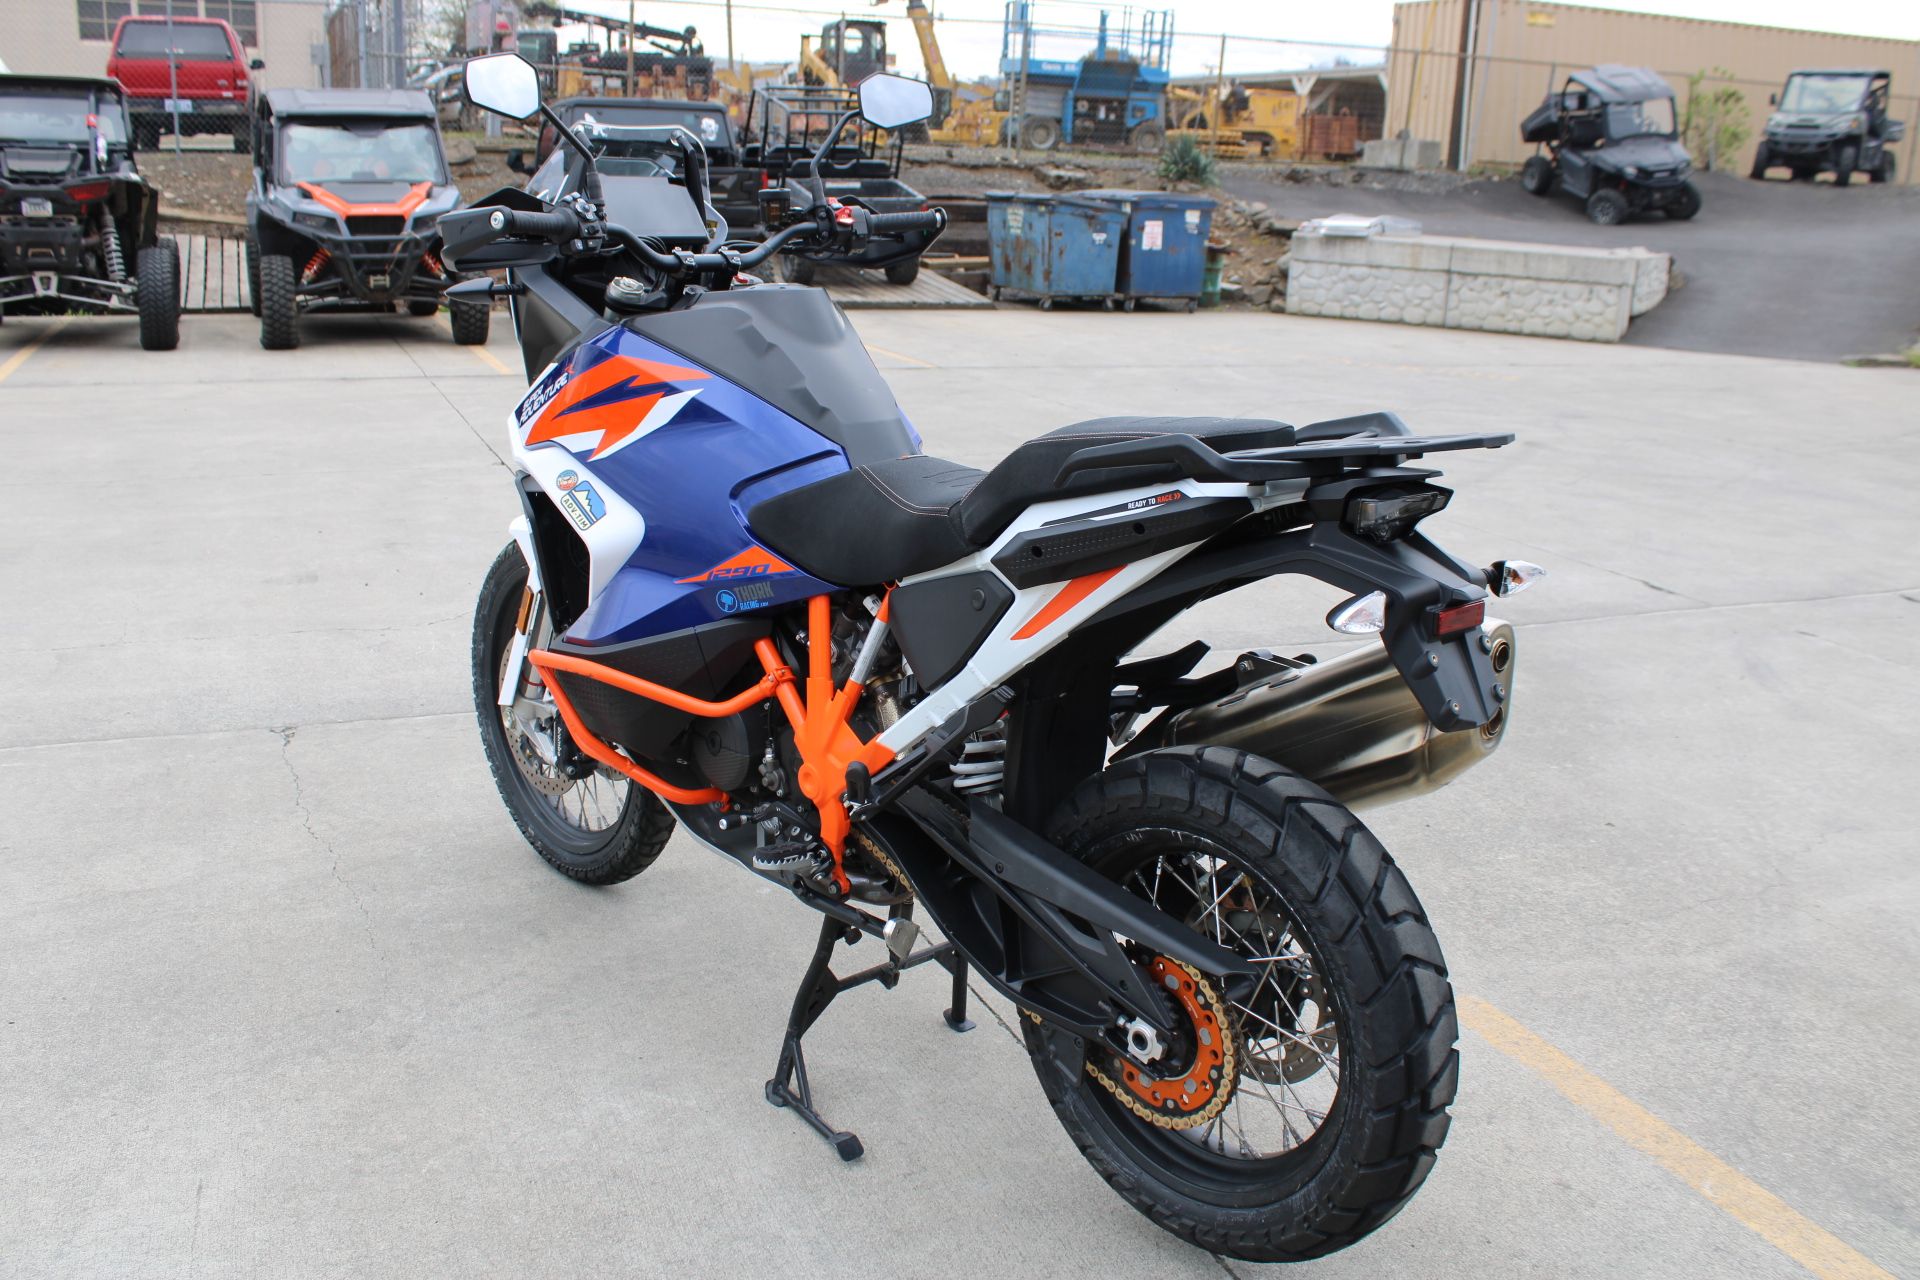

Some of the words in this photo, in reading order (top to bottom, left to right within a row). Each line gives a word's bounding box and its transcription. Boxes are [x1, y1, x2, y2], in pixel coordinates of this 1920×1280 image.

[519, 372, 569, 425] ADVENTURE
[522, 384, 544, 413] SUPER
[563, 498, 589, 529] ADV-TIM
[1127, 499, 1147, 510] READY
[1148, 497, 1156, 505] TO
[1157, 494, 1173, 504] RACE
[706, 563, 771, 584] 1290
[734, 581, 774, 602] THORK
